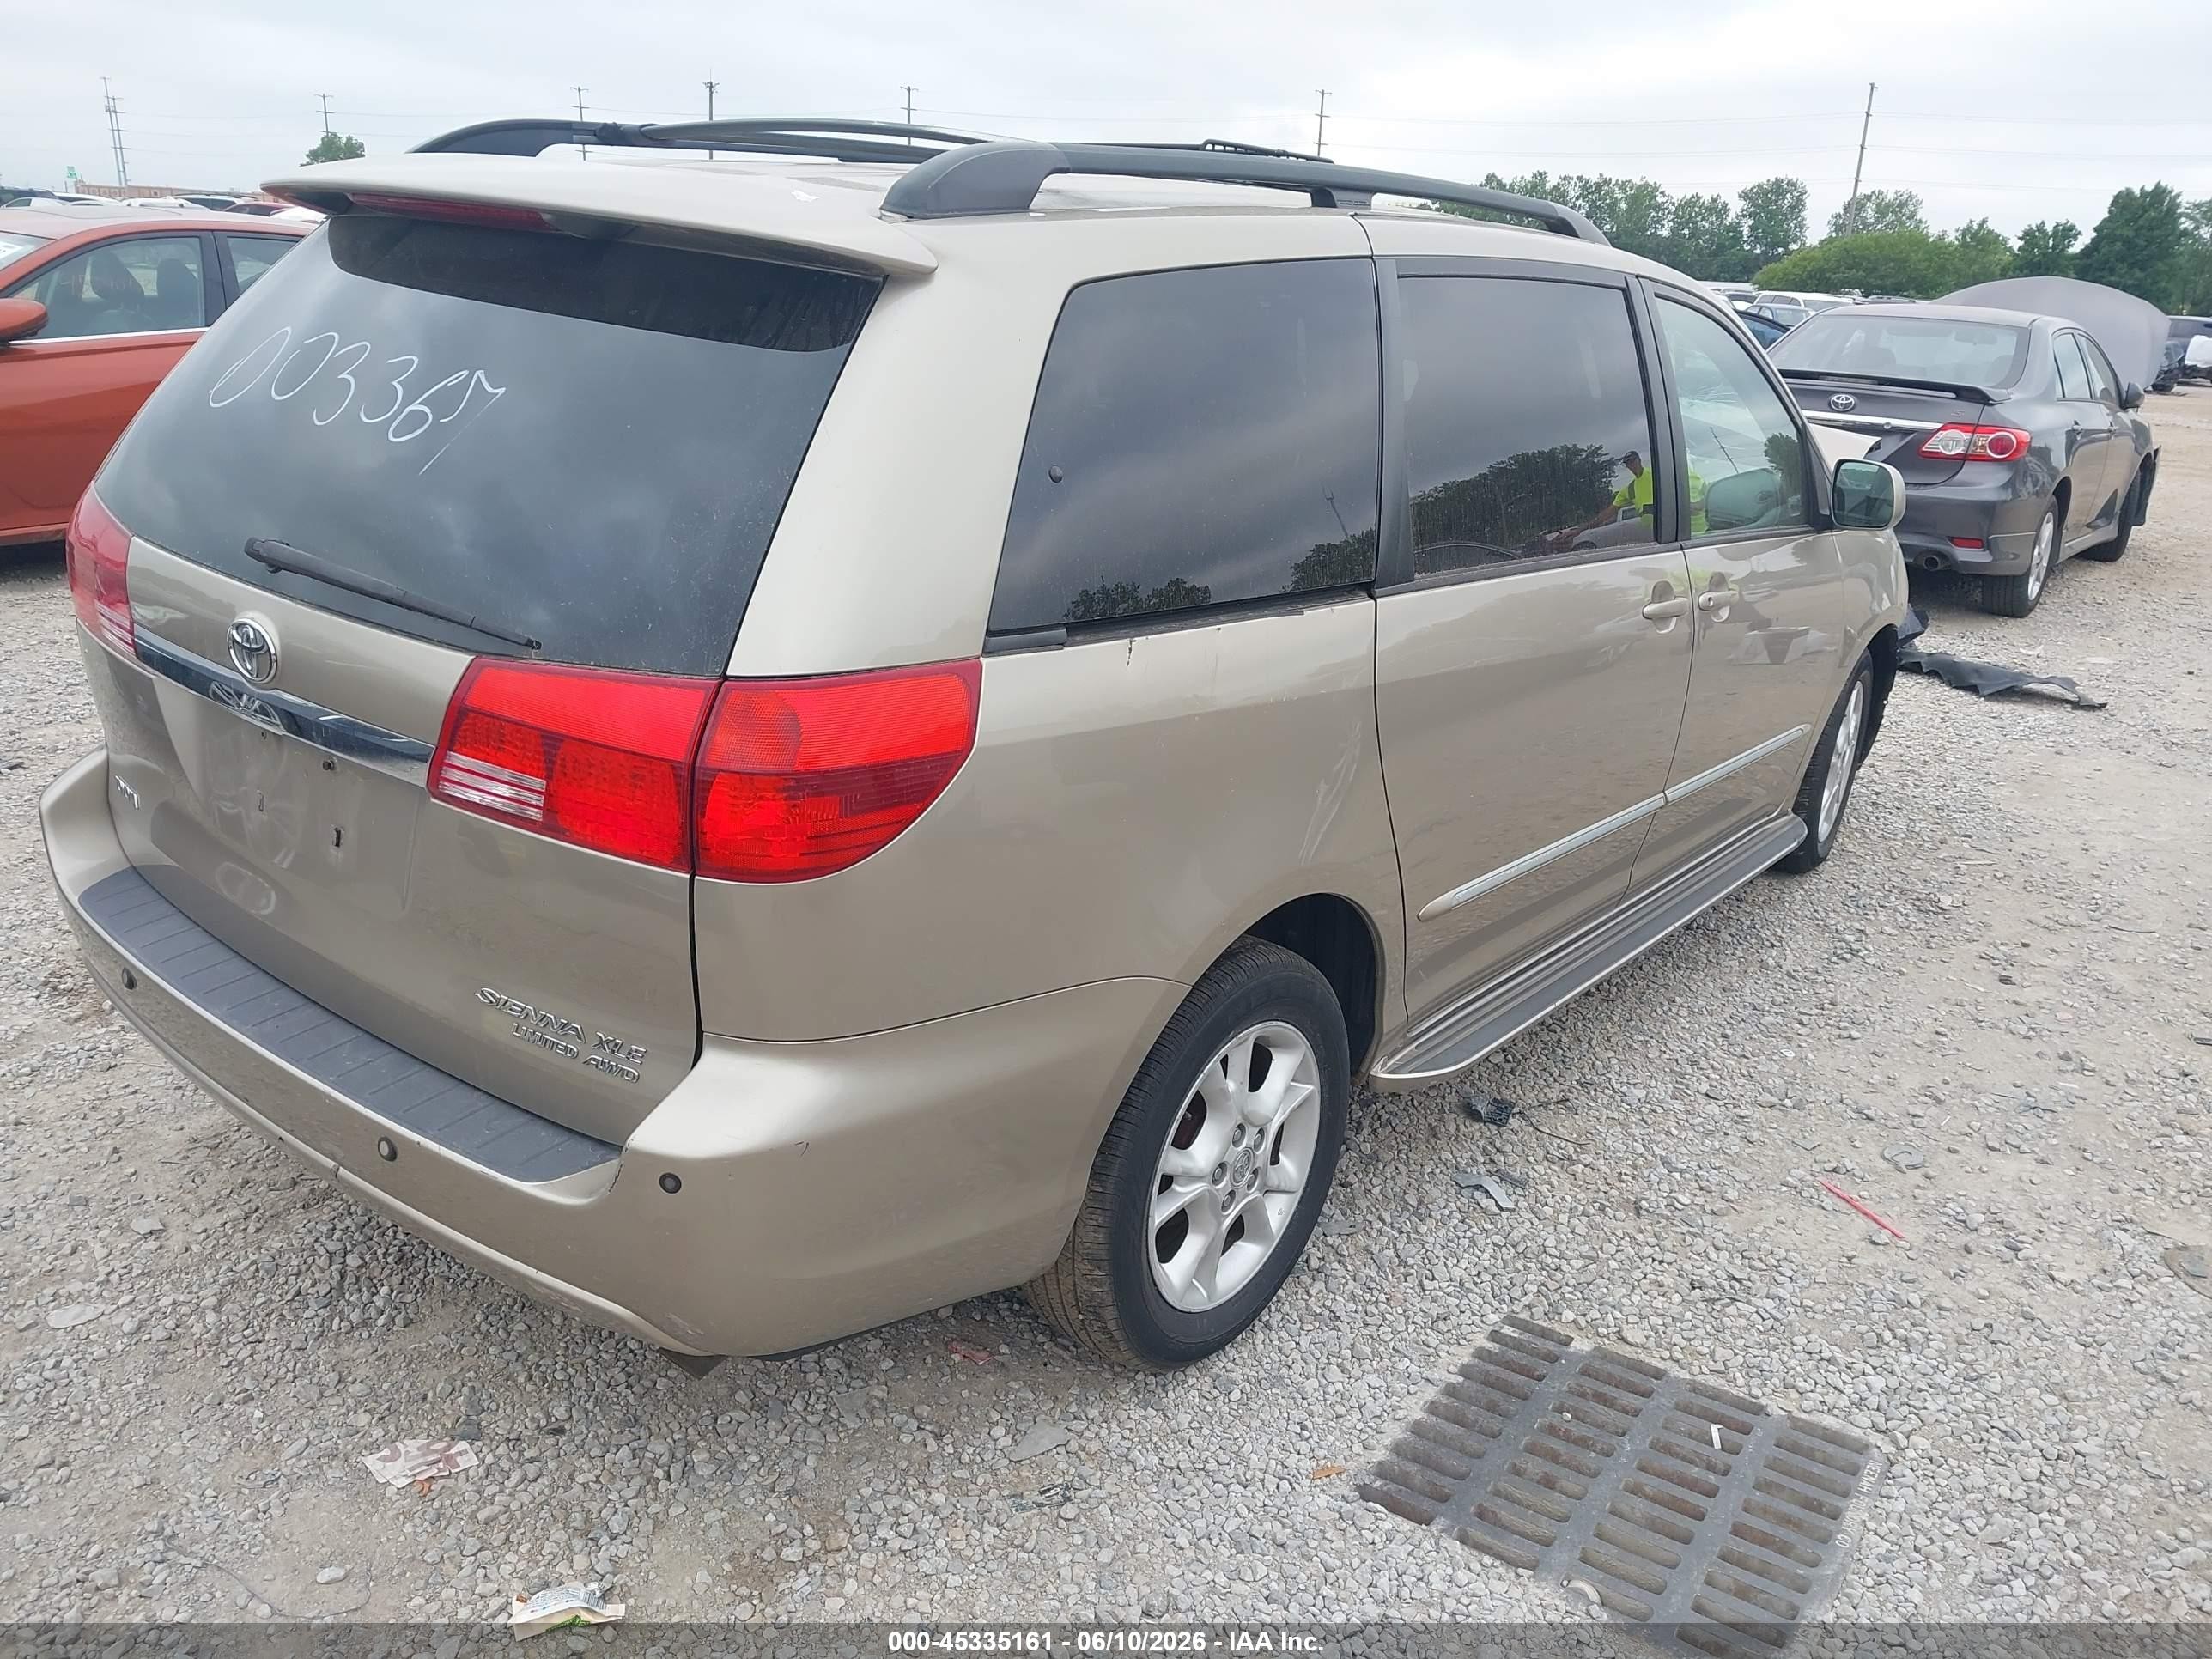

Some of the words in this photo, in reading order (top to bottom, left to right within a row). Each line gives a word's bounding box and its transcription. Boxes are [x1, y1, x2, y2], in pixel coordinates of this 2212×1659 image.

[474, 988, 586, 1045] SIENNA
[592, 1031, 647, 1066] XLE
[512, 1022, 580, 1060] LIMITED
[582, 1054, 641, 1084] AWD
[1857, 1460, 1882, 1494] NEENAH
[1835, 1534, 1852, 1548] CO
